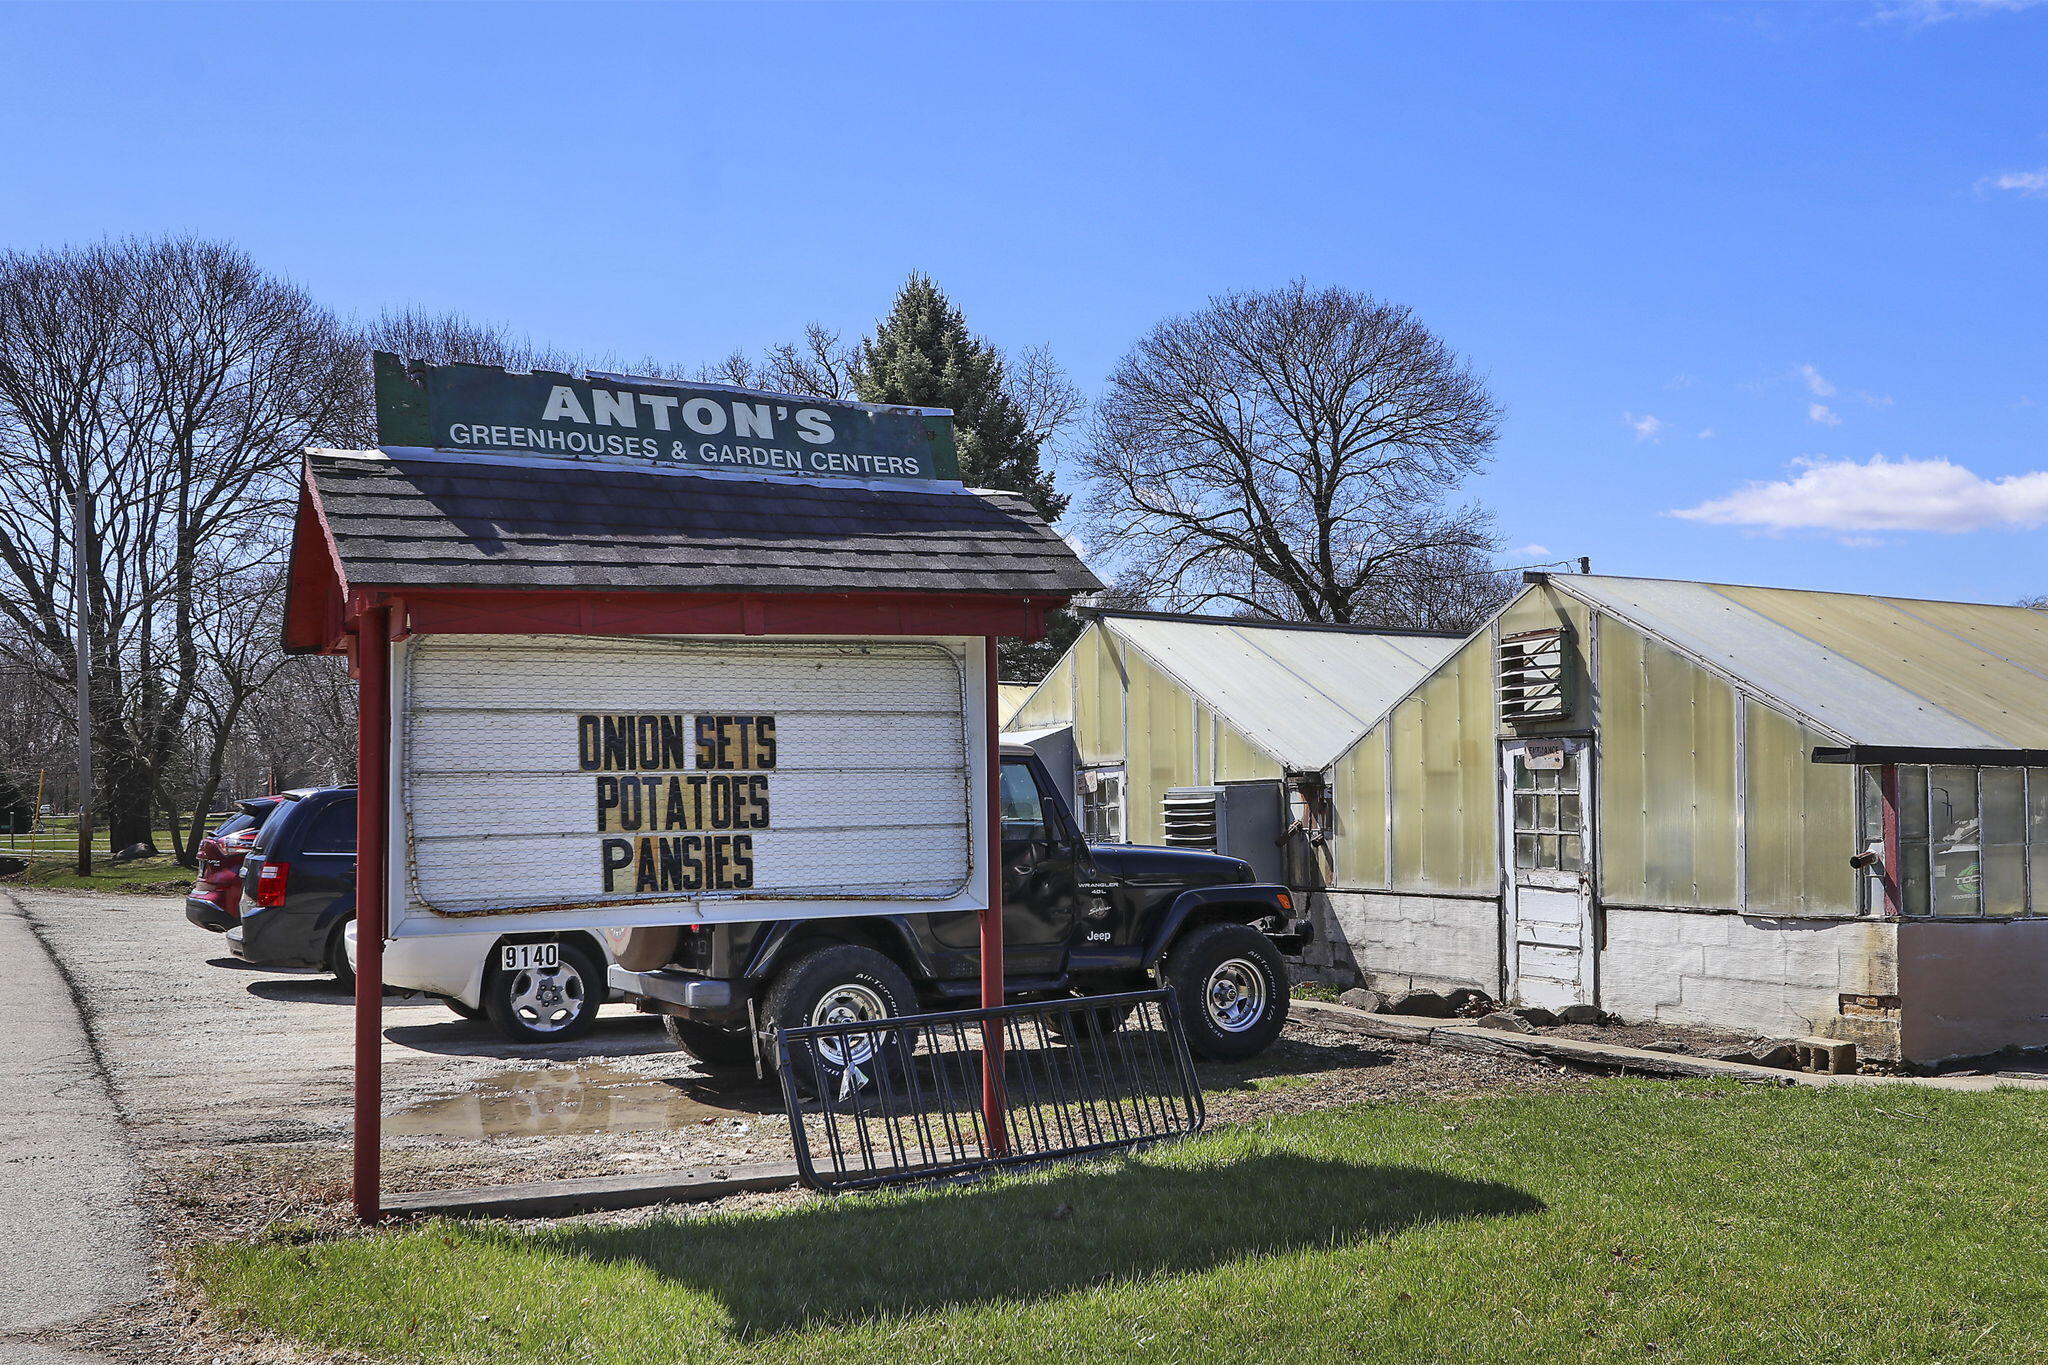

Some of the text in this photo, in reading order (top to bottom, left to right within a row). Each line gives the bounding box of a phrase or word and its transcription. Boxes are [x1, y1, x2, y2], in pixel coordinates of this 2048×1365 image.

[542, 385, 836, 445] ANTON'S
[450, 423, 920, 475] GREENHOUSES & GARDEN CENTERS
[579, 715, 777, 771] ONION SETS
[597, 775, 770, 832] POTATOES
[602, 835, 754, 893] PANSIES
[505, 944, 557, 969] 9140
[1086, 930, 1111, 942] Jeep
